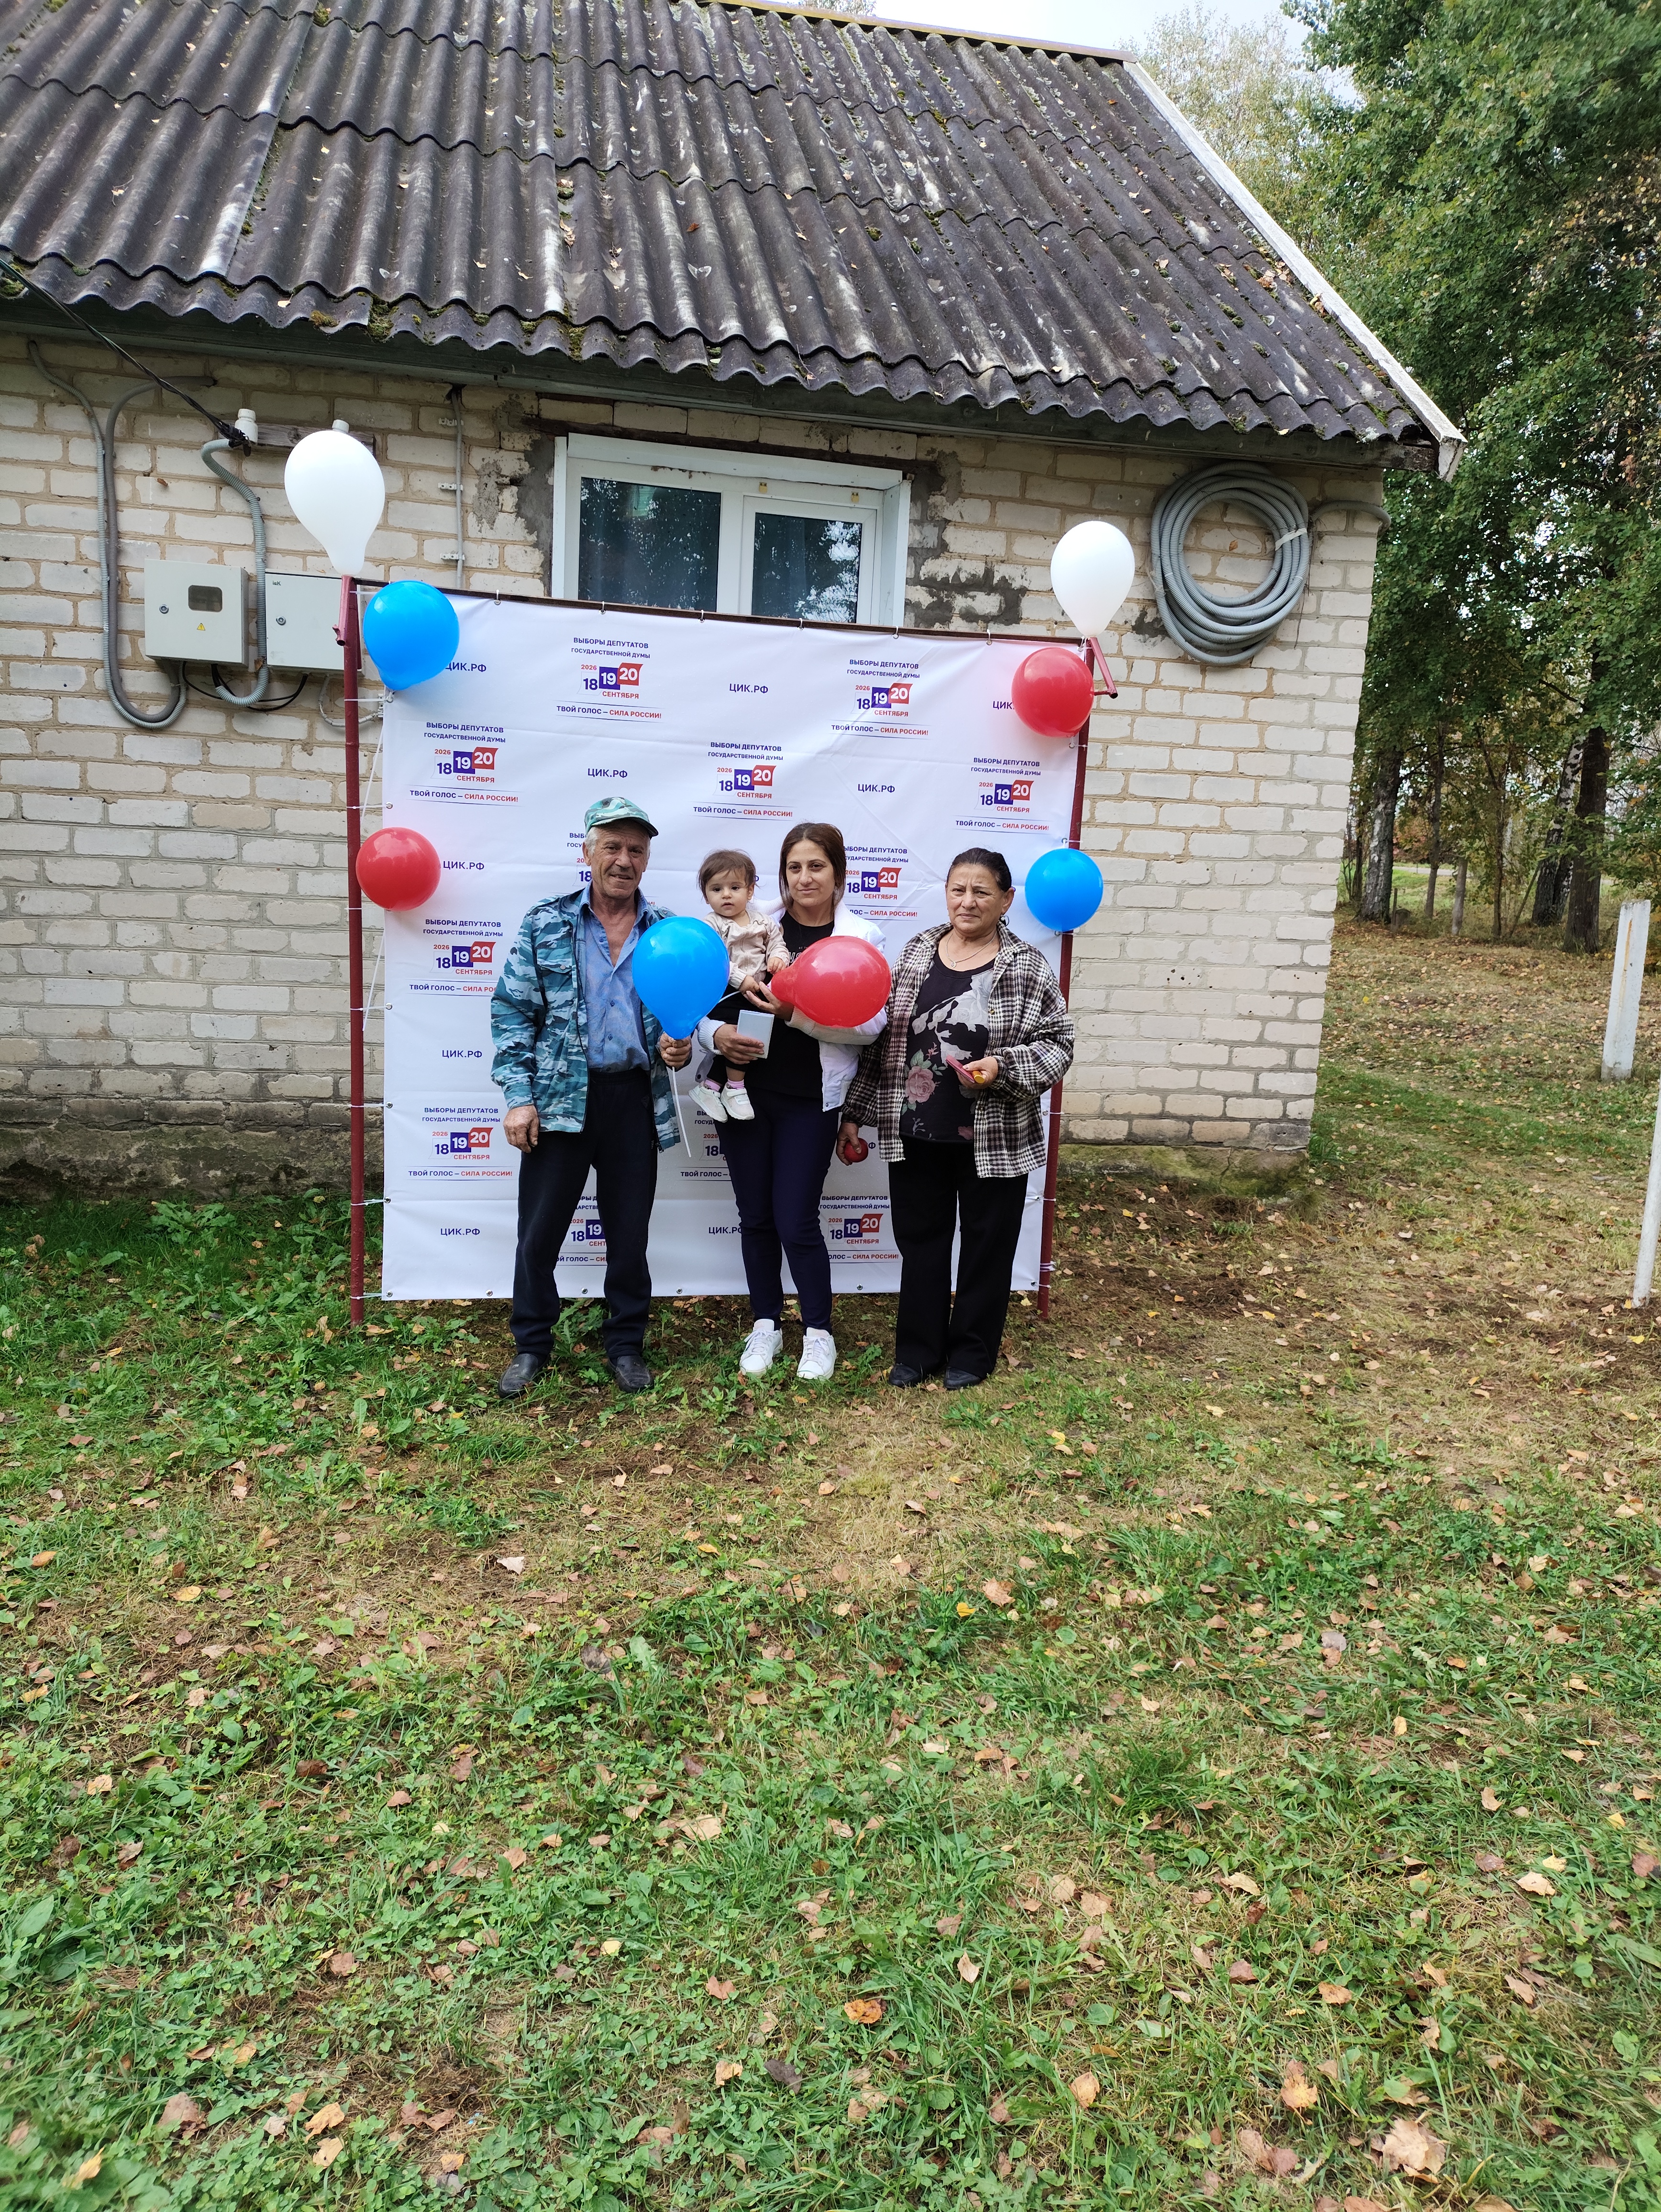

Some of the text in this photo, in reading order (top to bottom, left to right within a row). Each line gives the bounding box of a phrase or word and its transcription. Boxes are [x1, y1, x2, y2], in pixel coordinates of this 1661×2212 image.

[573, 637, 649, 649] ВЫБОРЫ ДЕПУТАТОВ
[571, 648, 631, 657] ГОСУДАРСТВЕННОЙ
[880, 661, 919, 669] ДЕПУТАТОВ
[847, 669, 902, 678] ГОСУДАРСТВЕННОЙ
[583, 669, 637, 690] 18 19 20
[729, 683, 768, 694] ЦИК.РФ
[602, 691, 639, 699] СЕНТЯБРЯ
[857, 688, 908, 709] 18 19 20
[993, 701, 1015, 710] ЦИК.
[630, 711, 662, 719] РОССИИ!
[426, 722, 504, 733] ВЫБОРЫ ДЕПУТАТОВ
[424, 732, 486, 741] ГОСУДАРСТВЕННОЙ
[710, 741, 741, 750] ВЫБОРЫ
[708, 752, 764, 760] ГОСУДАРСТВЕННОЙ
[437, 752, 493, 774] 18 19 20
[587, 768, 628, 778] ЦИК.РФ
[456, 775, 495, 783] СЕНТЯБРЯ
[719, 770, 771, 791] 18 19 20
[858, 784, 895, 793] ЦИК.РФ
[980, 785, 1029, 806] 18 19 20
[443, 861, 485, 871] ЦИК.РФ
[578, 871, 592, 882] 18
[847, 872, 897, 893] 18 19 20
[436, 946, 490, 968] 18 19 20
[442, 1050, 482, 1059] ЦИК.РФ
[435, 1133, 488, 1154] 18 19 20
[705, 1145, 719, 1156] 18
[440, 1228, 480, 1237] ЦИК.РФ
[571, 1224, 602, 1242] 18 19
[830, 1218, 878, 1239] 18 19 20
